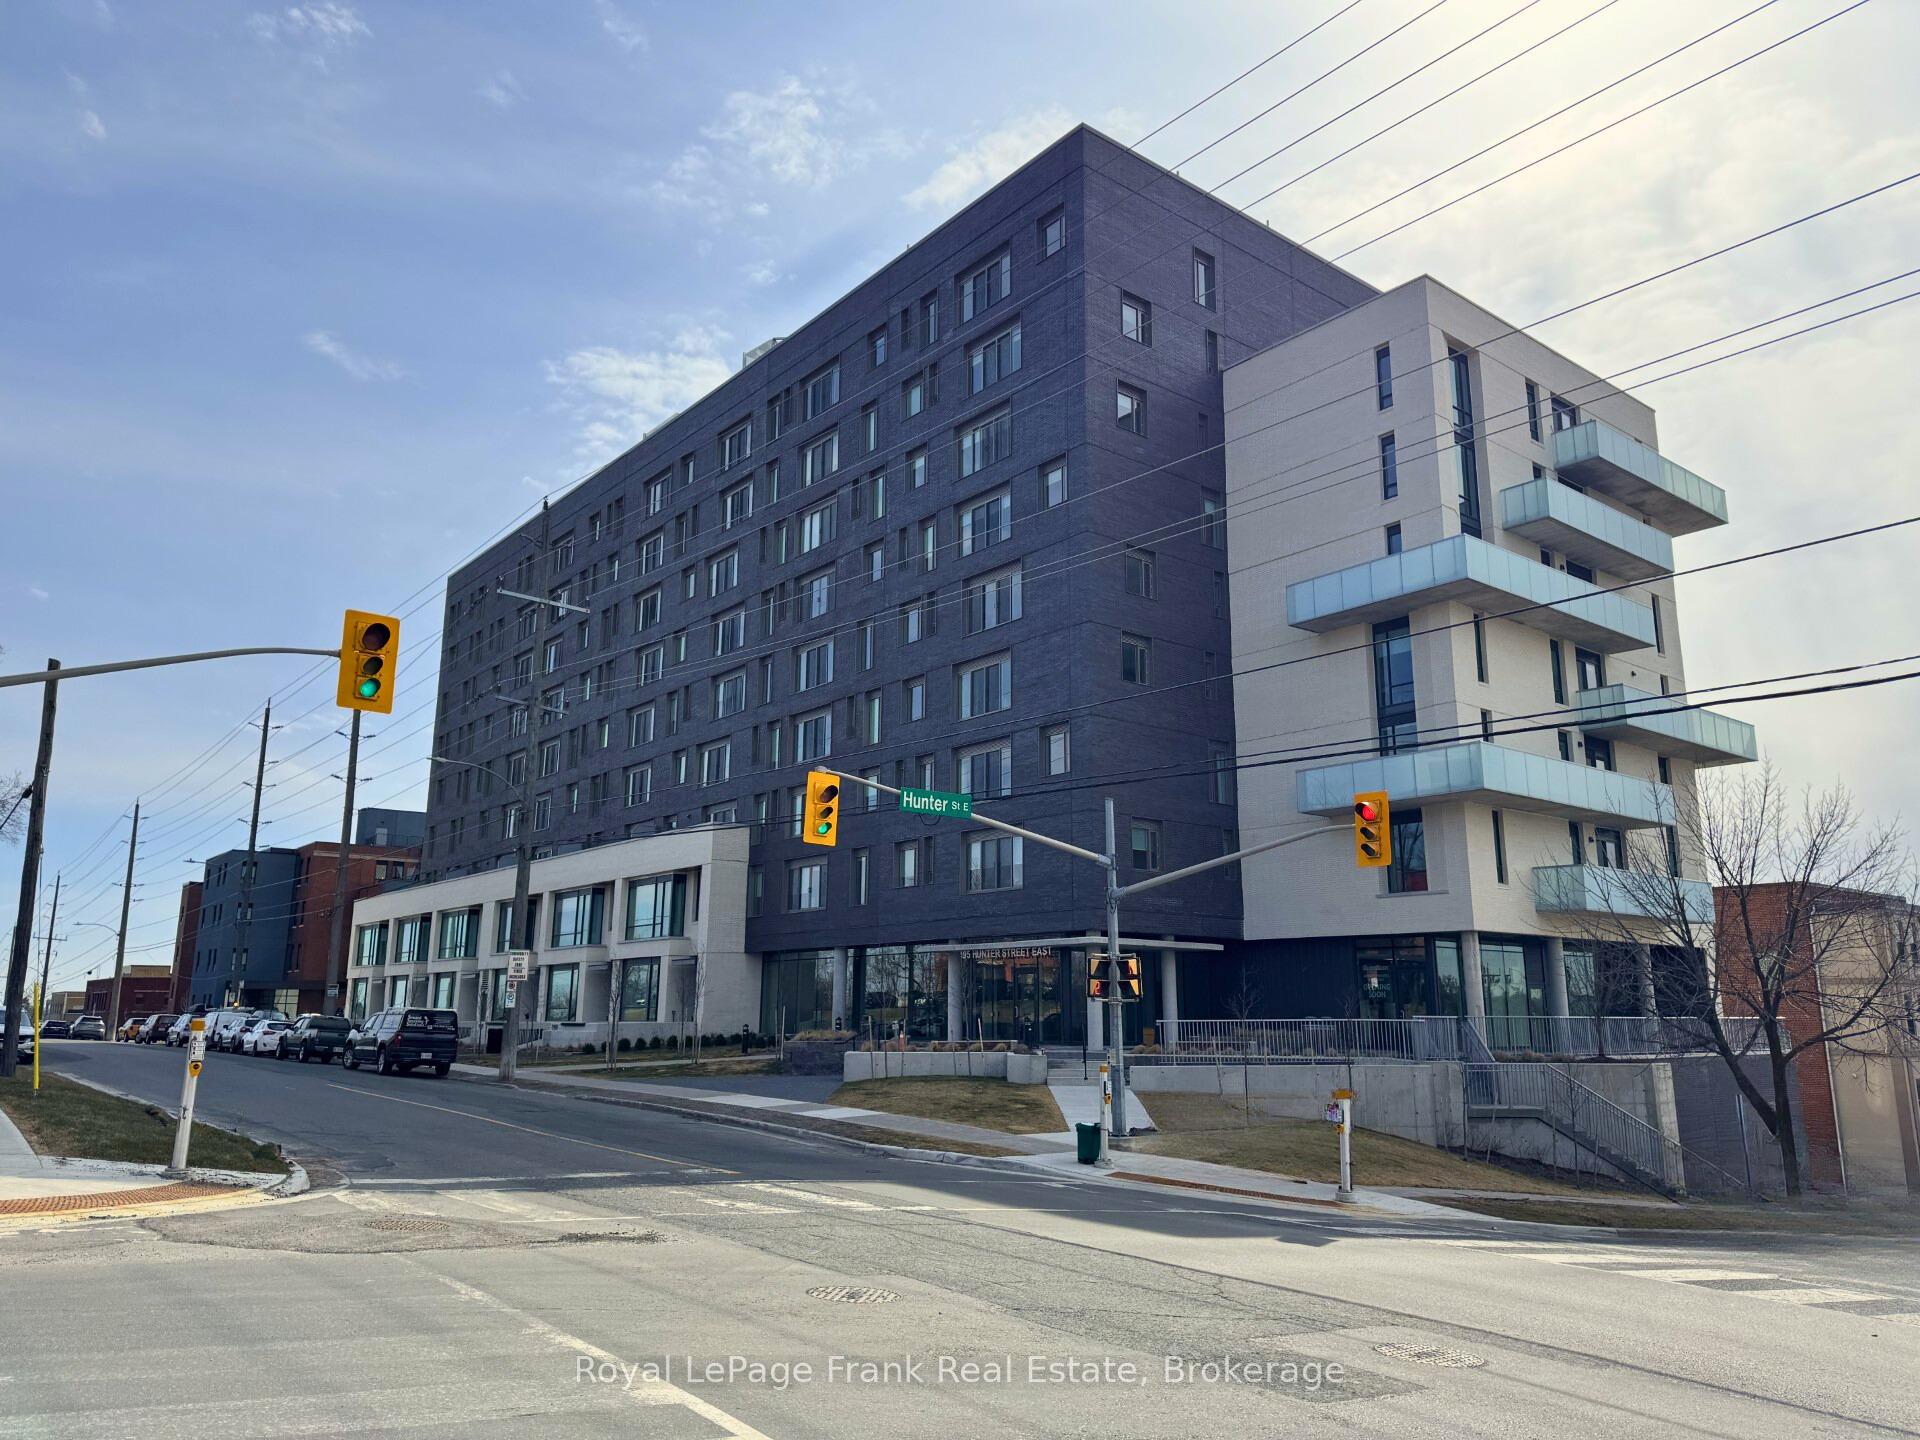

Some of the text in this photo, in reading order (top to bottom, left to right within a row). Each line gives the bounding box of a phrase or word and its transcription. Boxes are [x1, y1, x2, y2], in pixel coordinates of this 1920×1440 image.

[903, 791, 969, 812] Hunter St E
[972, 948, 1000, 959] HUNTER
[1002, 947, 1029, 958] STREET
[1031, 946, 1051, 956] EAST
